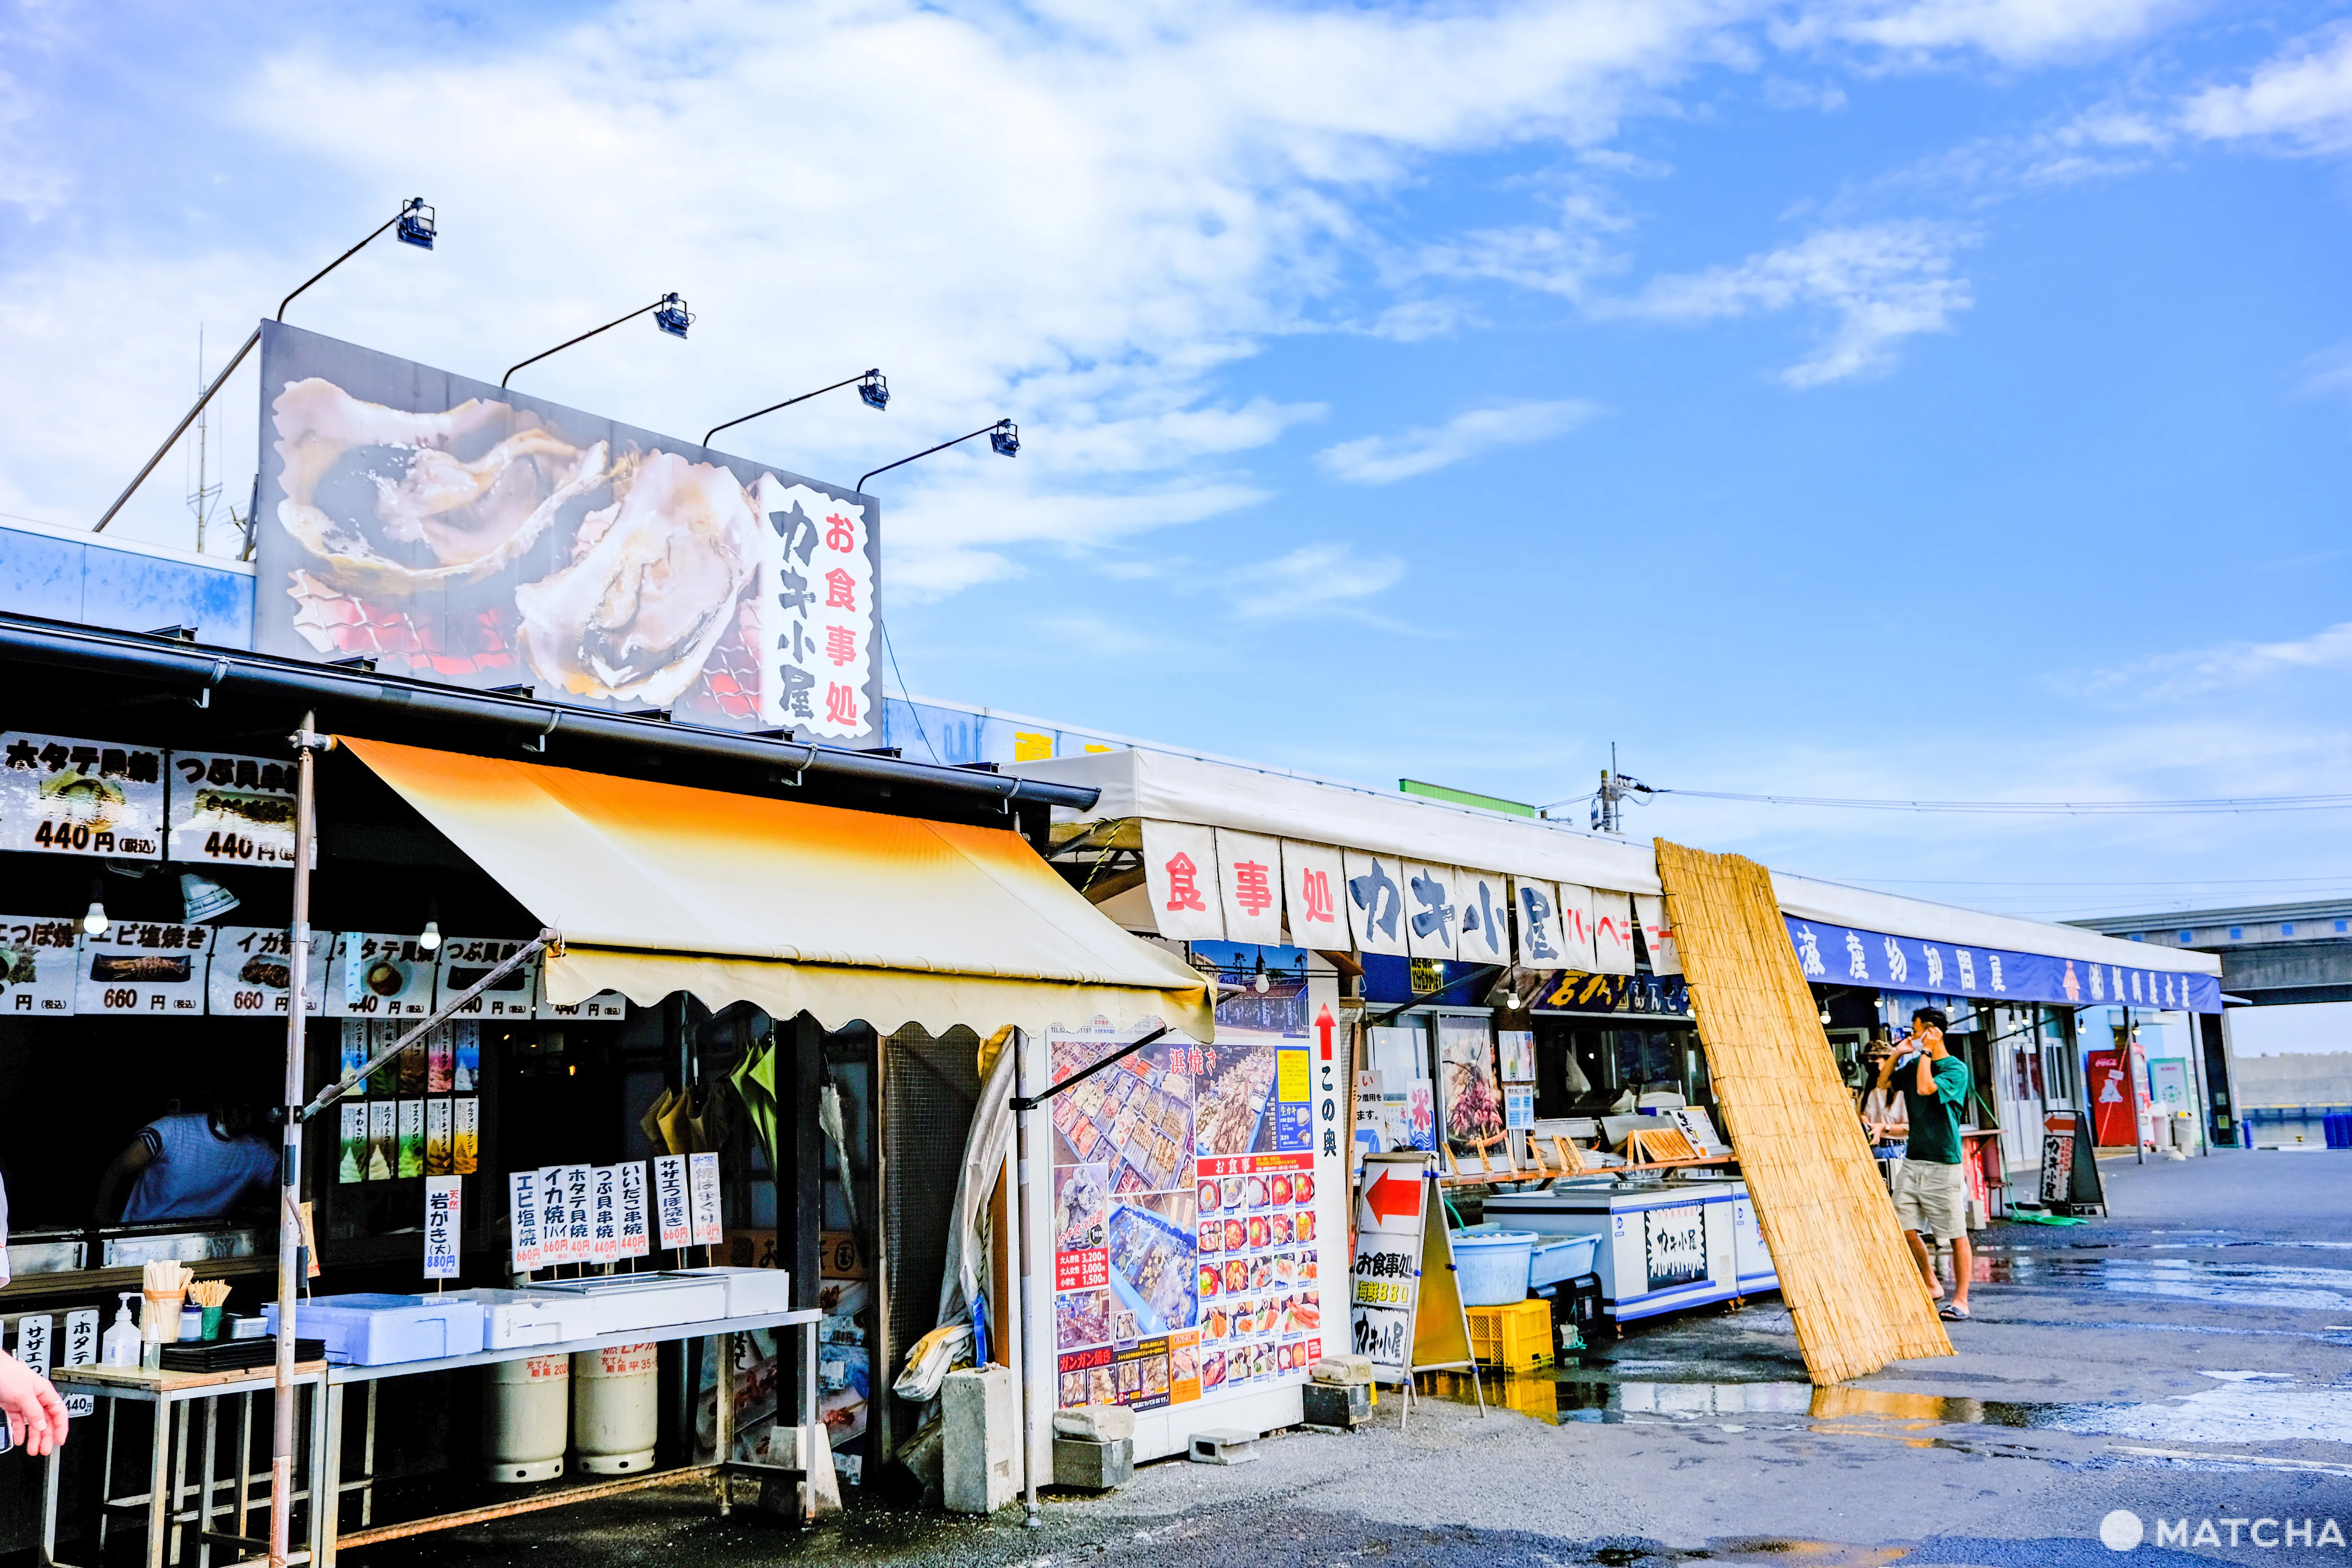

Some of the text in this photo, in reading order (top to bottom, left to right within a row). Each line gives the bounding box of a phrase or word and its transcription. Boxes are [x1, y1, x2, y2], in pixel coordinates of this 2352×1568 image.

[769, 500, 819, 720] カキ小屋
[825, 513, 857, 726] お食事処
[5, 740, 159, 784] ホタテ貝焼
[35, 821, 115, 852] 440円
[205, 831, 276, 861] 440円
[1166, 852, 1334, 923] 食事処
[1349, 857, 1559, 960] カキ小屋
[90, 923, 207, 949] エビ塩焼き
[1797, 924, 2006, 992] 海産物卸問屋
[41, 999, 67, 1010] (税込)
[1169, 1046, 1217, 1077] 浜焼き
[1322, 1066, 1337, 1157] この奥
[1412, 1087, 1430, 1131] 氷
[1216, 1157, 1251, 1174] お食事
[545, 1168, 564, 1224] イカ焼
[569, 1169, 588, 1238] ホタテ貝焼
[596, 1170, 614, 1239] つぶ貝串焼
[622, 1165, 643, 1236] いいだこ串焼
[695, 1168, 715, 1223] 焼はまぐり
[517, 1176, 536, 1246] エビ塩焼
[621, 1235, 646, 1249] 440円
[663, 1227, 688, 1240] 660円
[695, 1223, 719, 1237] 660円
[517, 1248, 541, 1262] 660円
[544, 1239, 568, 1253] 660円
[594, 1240, 617, 1254] 440円
[1060, 1251, 1105, 1265] 大人男性 3,200円
[427, 1255, 455, 1268] 880円
[1060, 1262, 1106, 1276] 大人女性 3,000円
[1356, 1251, 1413, 1280] お食事処
[1060, 1273, 1106, 1287] 小学生 1,500円
[1356, 1280, 1409, 1304] 海鮮BBQ
[1355, 1311, 1404, 1359] カキ小屋
[25, 1326, 44, 1377] サザエつ
[1060, 1348, 1112, 1372] ガンガン焼き
